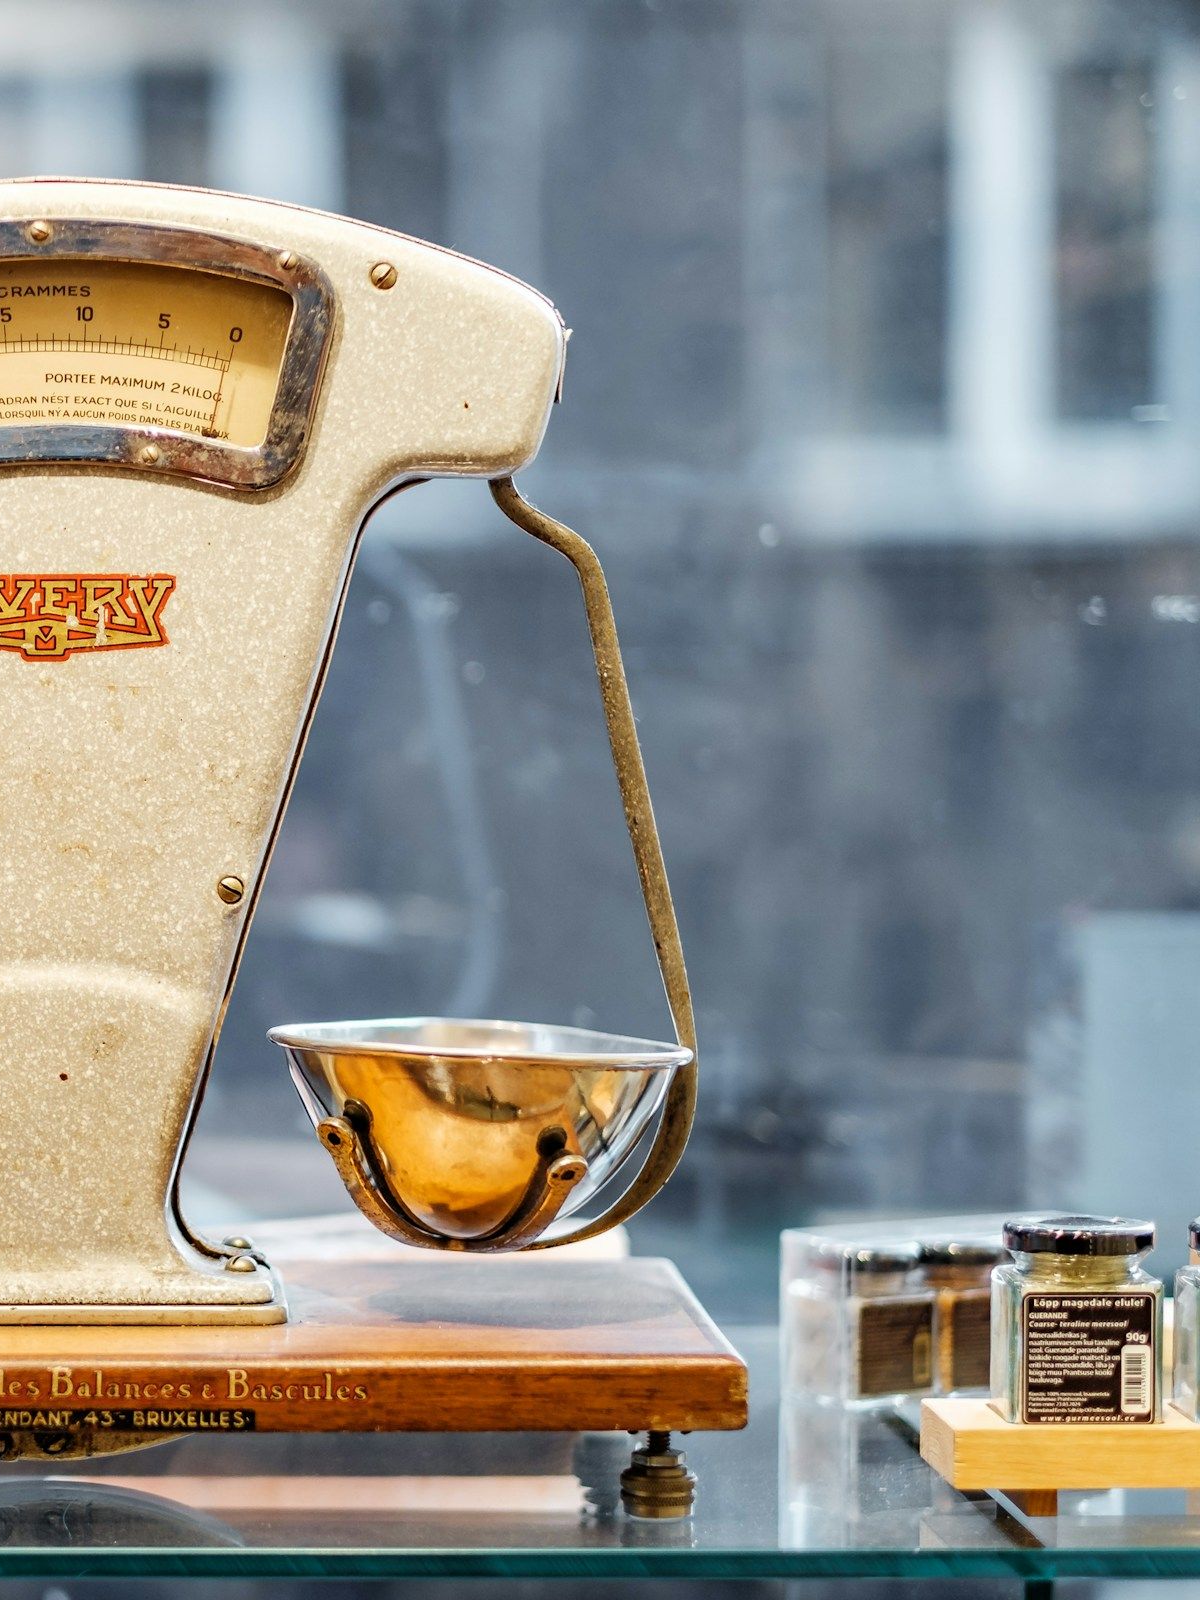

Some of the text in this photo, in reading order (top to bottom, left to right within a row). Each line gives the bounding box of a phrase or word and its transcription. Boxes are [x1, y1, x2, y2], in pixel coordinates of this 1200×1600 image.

[76, 306, 94, 322] 10
[157, 314, 170, 329] 5
[229, 327, 243, 343] 0
[45, 373, 96, 384] PORTEE
[100, 375, 165, 391] MAXIMUM
[74, 395, 113, 406] EXACT
[114, 398, 138, 409] QUE
[141, 401, 152, 411] SI
[73, 410, 106, 419] AUCUN
[108, 411, 137, 422] POIDS
[139, 415, 164, 426] DANS
[166, 419, 181, 429] LES
[1061, 1298, 1112, 1308] magedale
[1114, 1298, 1144, 1307] elule!
[1029, 1311, 1068, 1320] GUERANDE
[1059, 1320, 1090, 1328] teraline
[1091, 1320, 1128, 1328] meresool
[1125, 1332, 1147, 1344] 90g
[51, 1366, 192, 1399] Balances
[226, 1368, 367, 1400] Bascules
